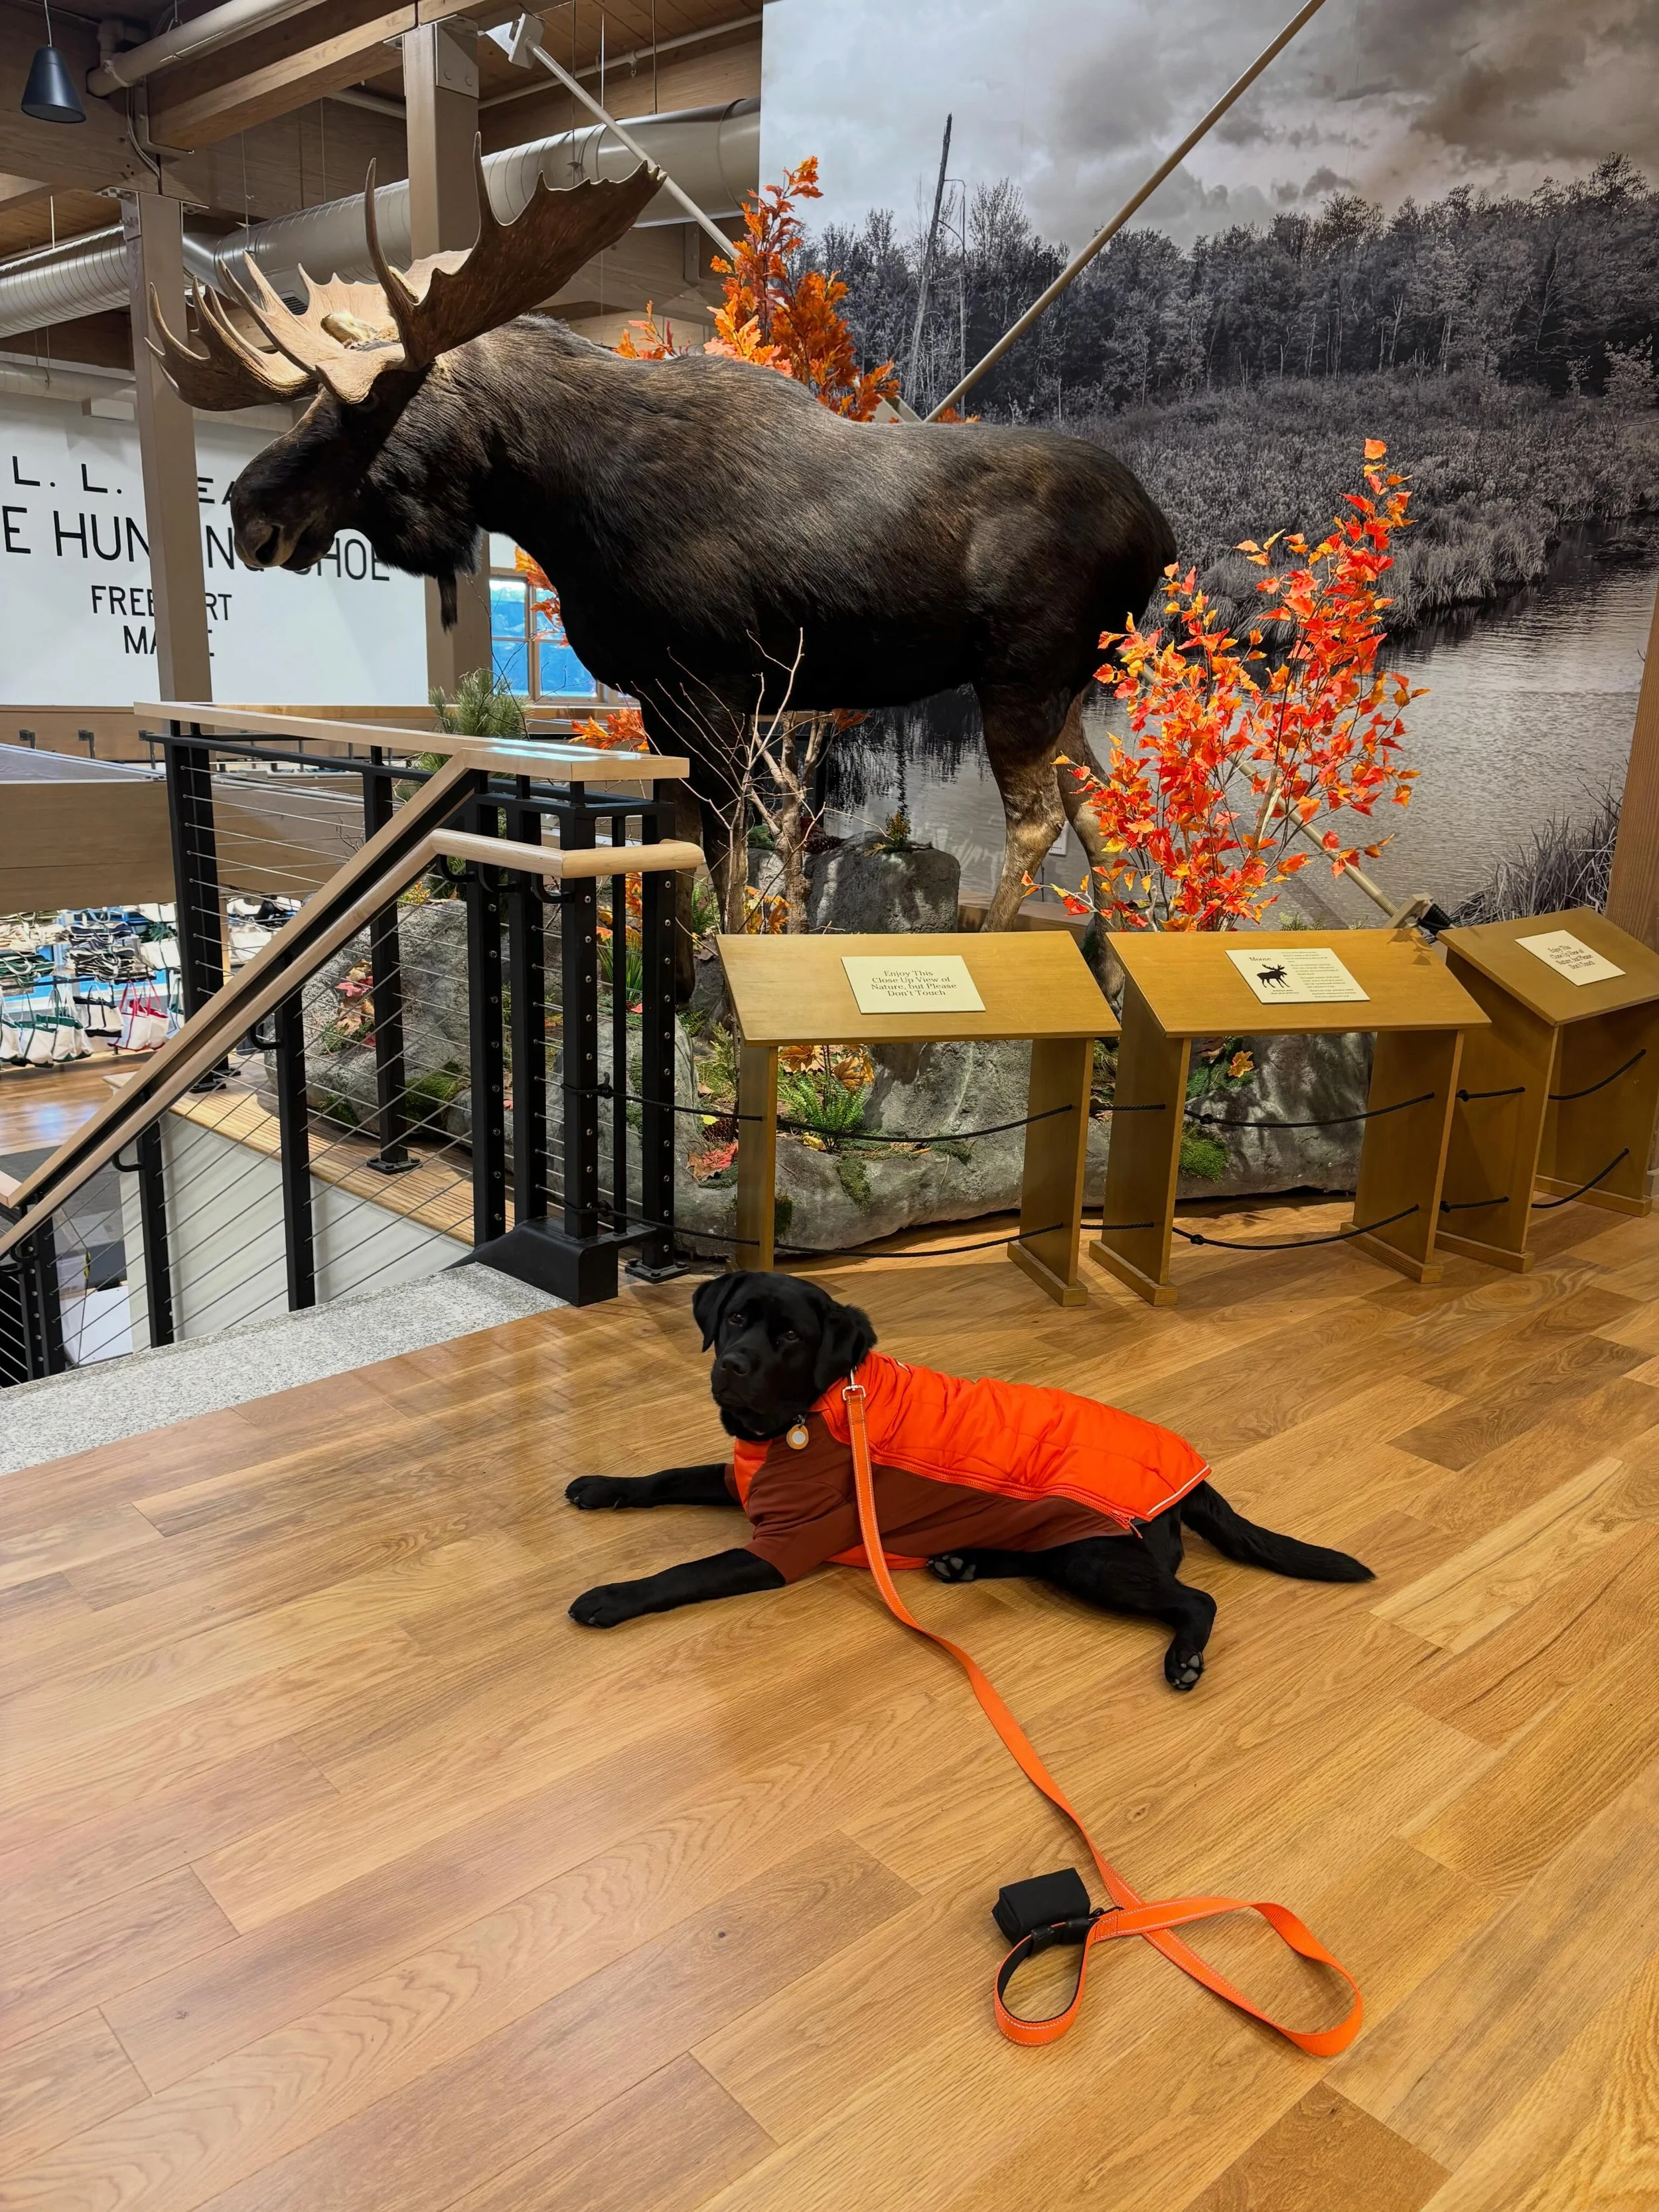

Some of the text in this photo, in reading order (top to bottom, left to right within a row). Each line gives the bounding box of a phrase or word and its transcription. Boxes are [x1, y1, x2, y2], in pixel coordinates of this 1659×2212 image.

[12, 455, 56, 487] L.
[81, 463, 122, 494] L.
[53, 510, 265, 571] HUNN
[293, 538, 390, 581] HOE
[91, 585, 232, 621] FREERT
